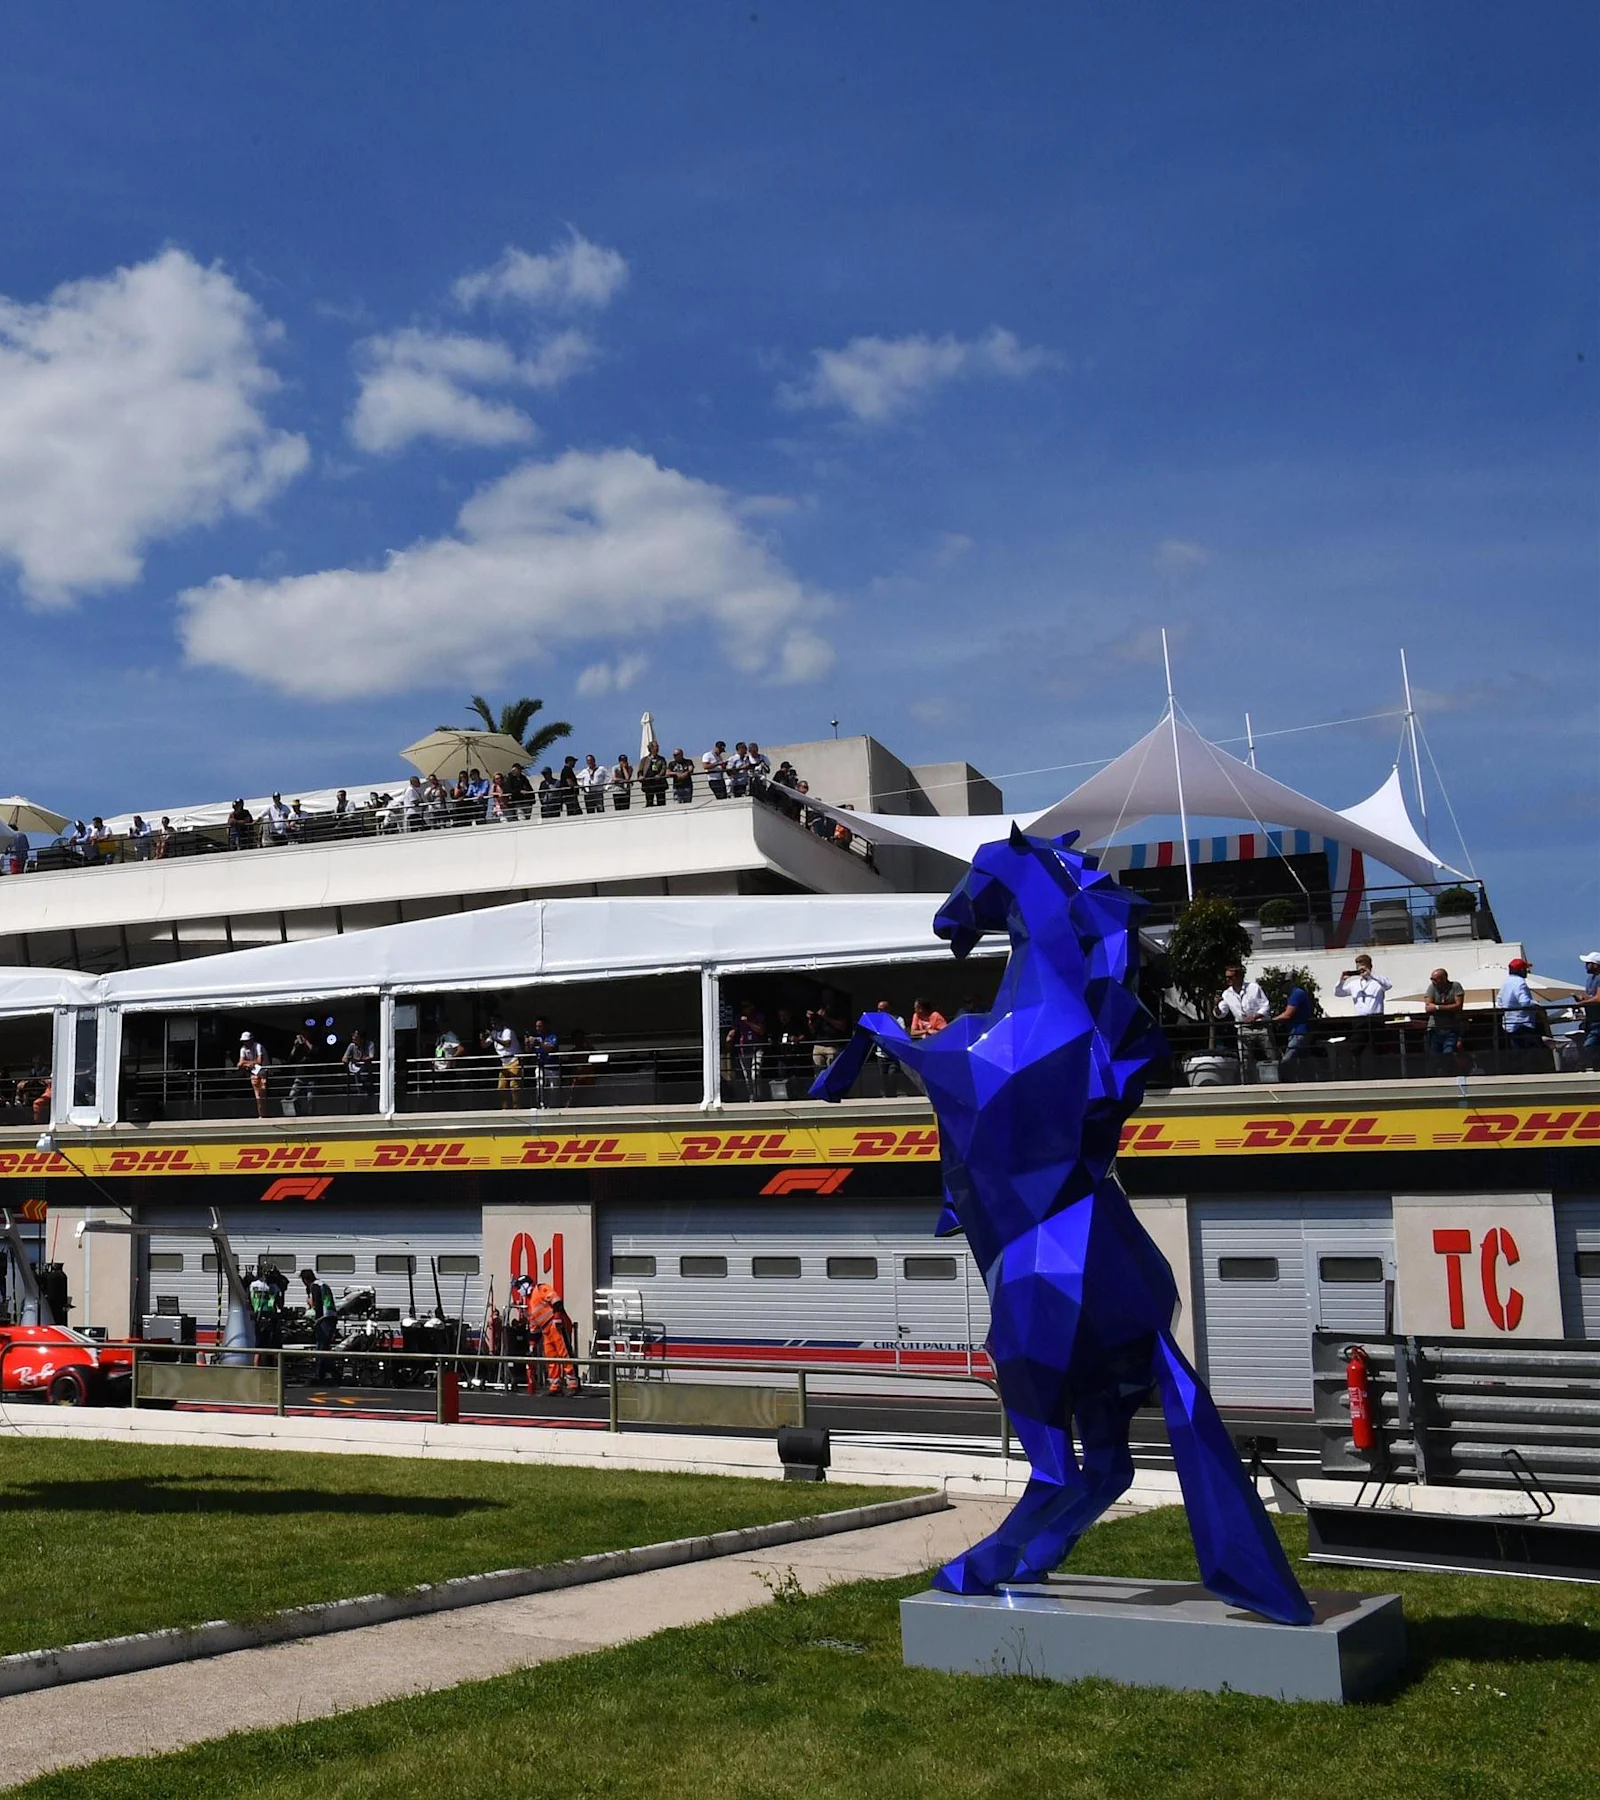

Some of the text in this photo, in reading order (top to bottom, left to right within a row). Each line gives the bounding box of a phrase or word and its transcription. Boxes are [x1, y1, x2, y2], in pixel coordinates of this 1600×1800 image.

[851, 1130, 938, 1156] DH
[1241, 1118, 1391, 1147] DHL
[235, 1147, 327, 1169] DHL
[372, 1143, 471, 1166] DHL
[519, 1139, 626, 1163] DHL
[678, 1134, 795, 1160] DHL
[108, 1150, 193, 1171] DHL
[260, 1177, 335, 1201] F1
[758, 1168, 854, 1195] F1
[510, 1232, 564, 1304] 01
[1432, 1227, 1524, 1331] TC
[873, 1341, 985, 1352] CIRCUIT PAUL RICA
